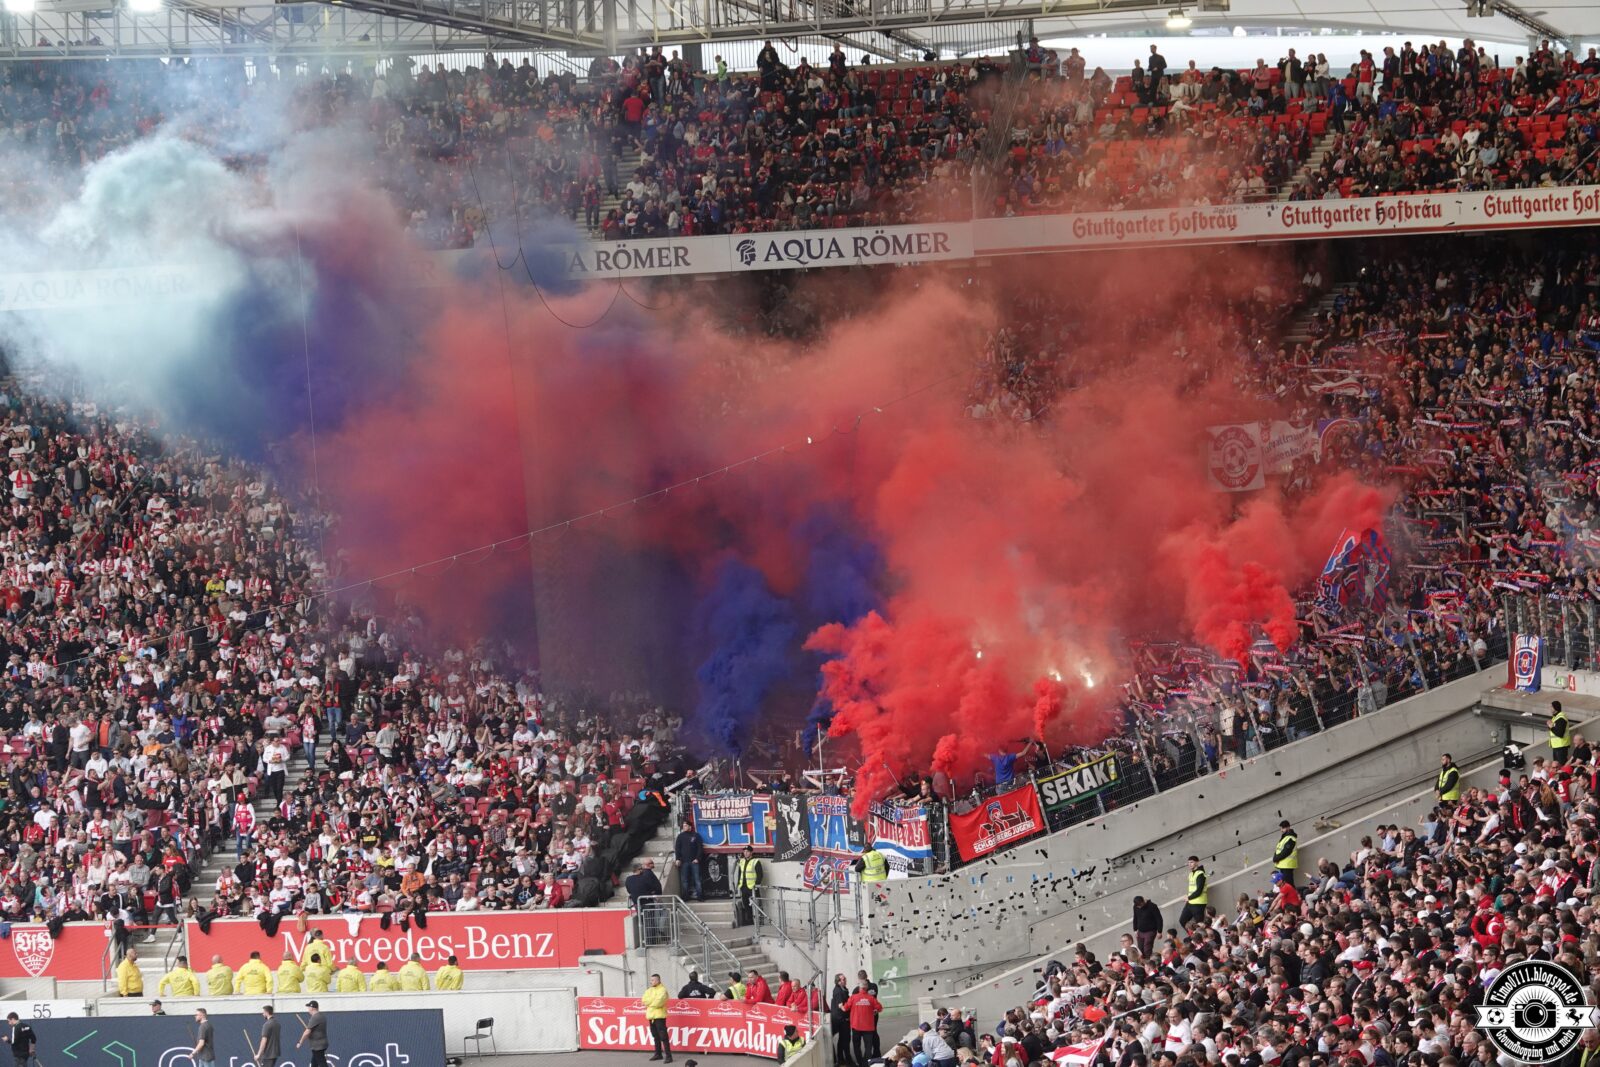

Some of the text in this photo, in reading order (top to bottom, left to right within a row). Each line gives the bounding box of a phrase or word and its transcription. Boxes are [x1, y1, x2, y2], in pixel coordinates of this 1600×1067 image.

[1281, 198, 1442, 229] Stuttgarter Hofbräu
[1484, 194, 1569, 219] Stuttgarter
[1072, 210, 1238, 240] Stuttgarter Hofbräu
[595, 243, 691, 271] RÖMER
[764, 229, 951, 265] AQUA RÖMER
[698, 798, 751, 809] LOVE FOOTBALL
[701, 807, 749, 818] HATE RACISM
[281, 926, 554, 962] Mercedes-Benz
[33, 1003, 52, 1019] 55
